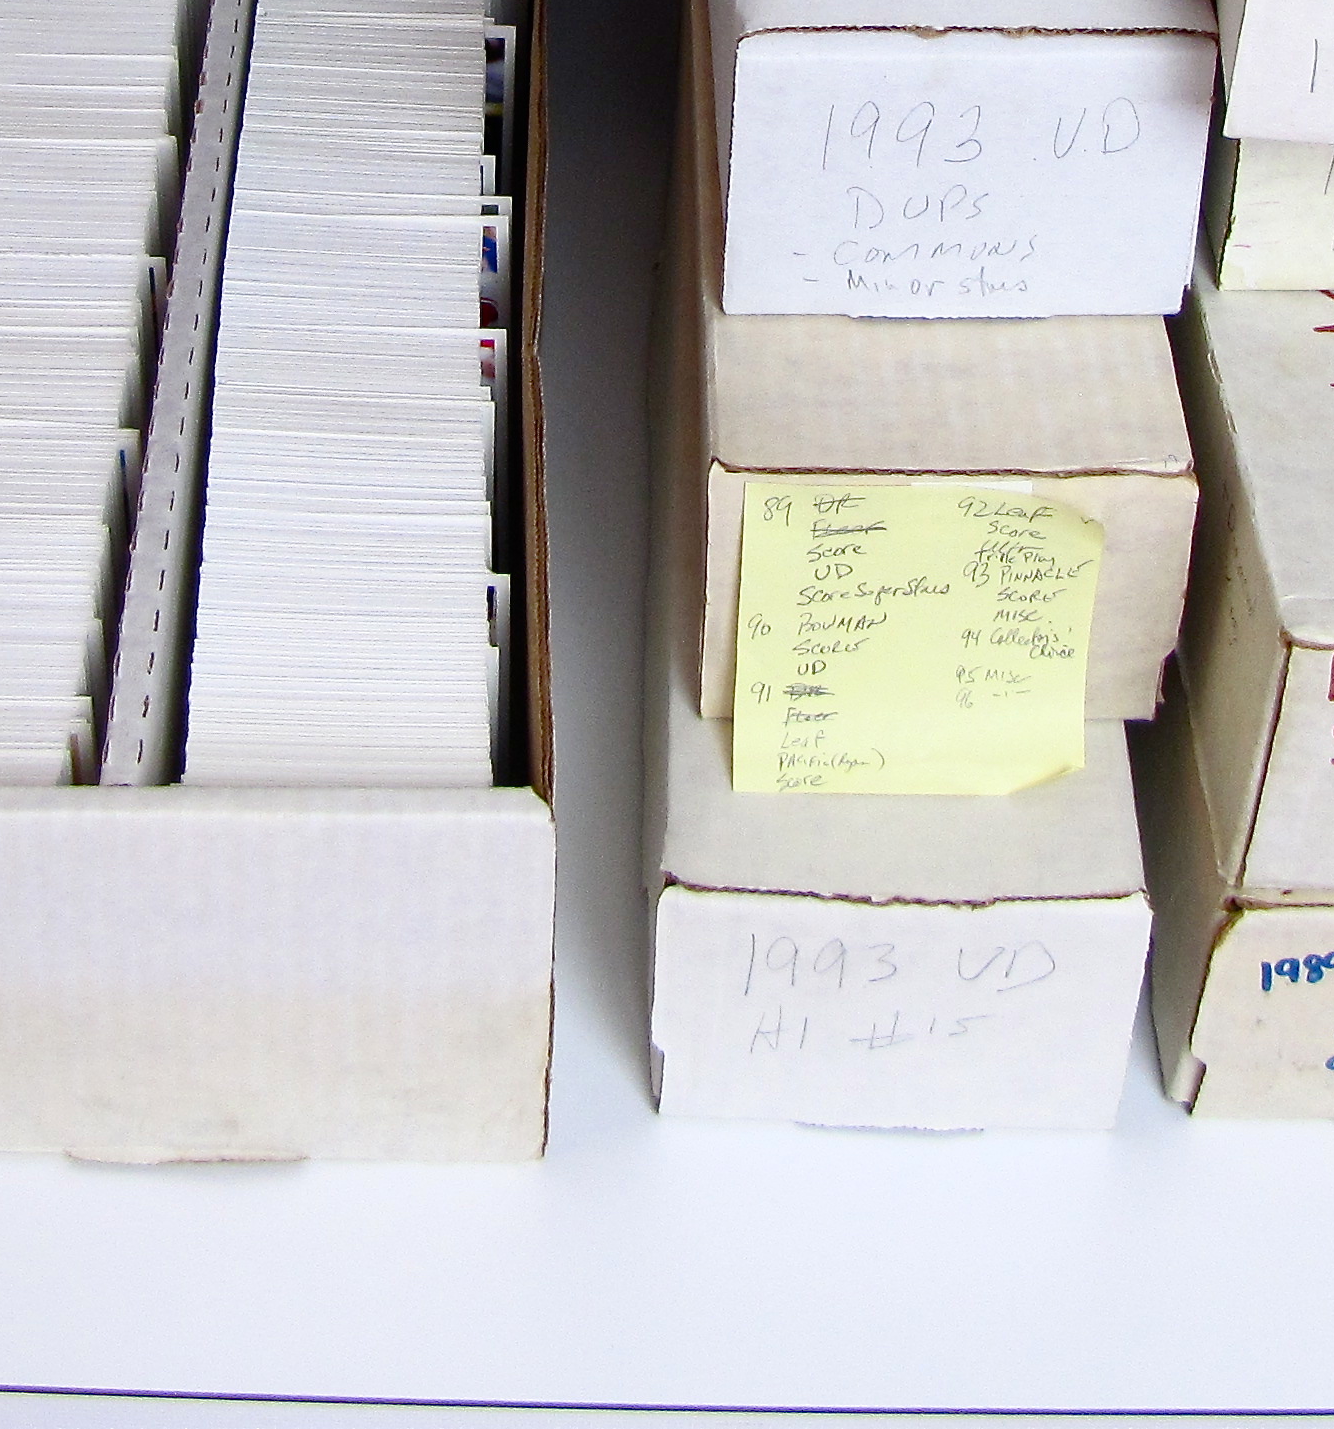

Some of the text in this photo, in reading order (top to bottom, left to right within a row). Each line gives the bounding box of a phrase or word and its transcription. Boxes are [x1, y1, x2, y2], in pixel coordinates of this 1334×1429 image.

[821, 100, 984, 170] 1993
[846, 184, 991, 230] DUPS
[763, 497, 793, 526] 89
[957, 498, 990, 520] 92
[988, 520, 1046, 541] Score
[814, 564, 854, 581] UD
[962, 561, 990, 588] 93
[748, 614, 771, 639] 90
[961, 628, 980, 646] 94
[797, 660, 827, 676] UD
[750, 682, 772, 704] 91
[744, 932, 898, 997] 1993
